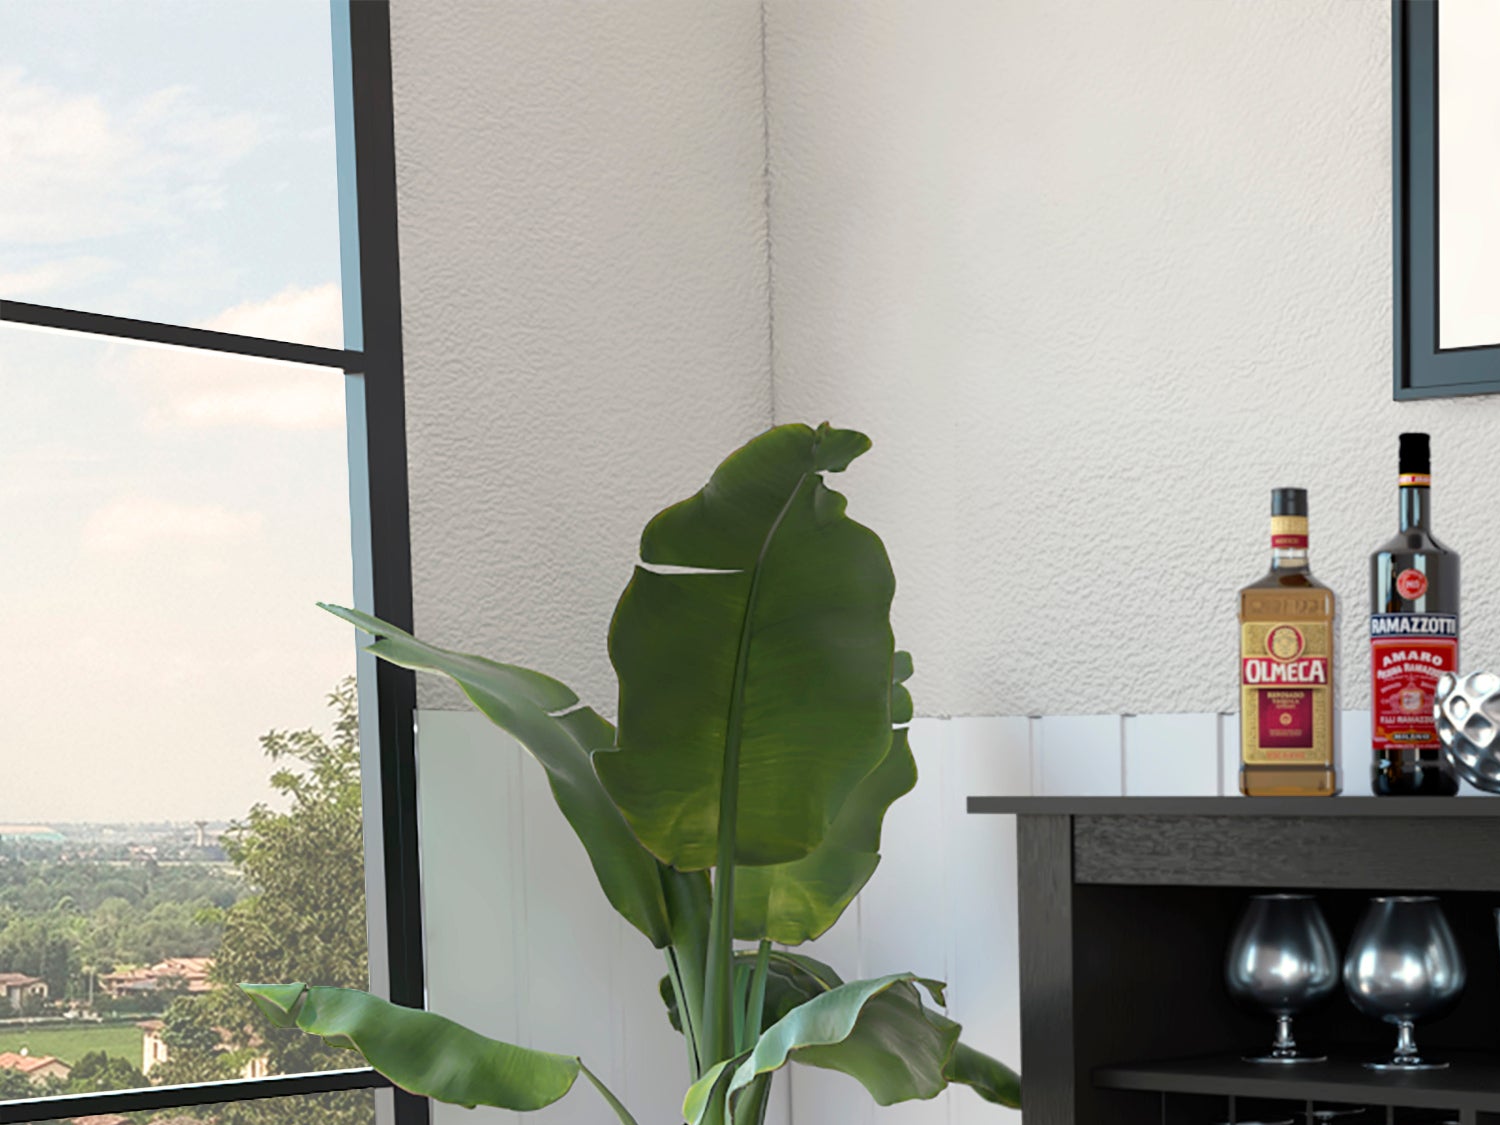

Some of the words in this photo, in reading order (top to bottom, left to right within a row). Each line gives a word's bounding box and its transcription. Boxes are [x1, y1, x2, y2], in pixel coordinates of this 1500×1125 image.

[1371, 617, 1456, 634] RAMAZZOTTI
[1382, 650, 1444, 668] AMARO
[1245, 659, 1326, 683] OLMECA
